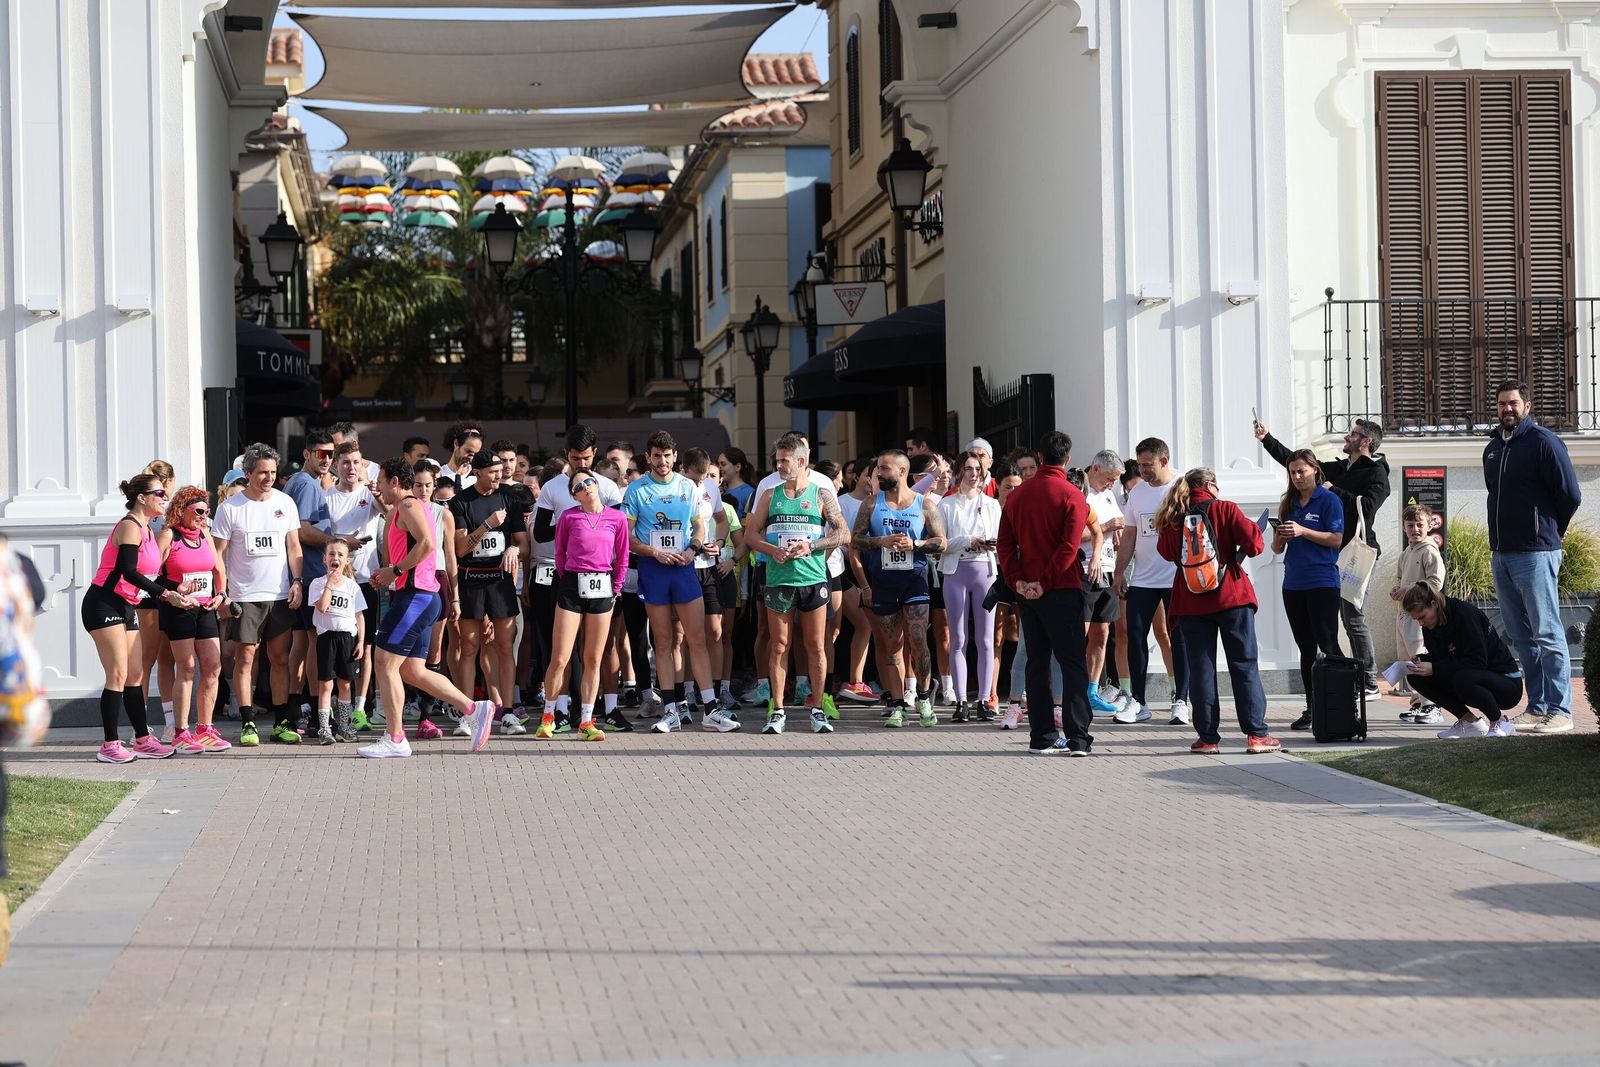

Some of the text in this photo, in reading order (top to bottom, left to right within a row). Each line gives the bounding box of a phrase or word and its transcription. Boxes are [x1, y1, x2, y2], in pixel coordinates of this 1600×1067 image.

[838, 290, 863, 298] GUESS
[776, 515, 809, 523] ATLETISMO
[883, 518, 911, 528] ERESO
[255, 536, 273, 548] 501
[481, 537, 497, 550] 108
[660, 536, 675, 547] 161
[890, 551, 906, 562] 169
[589, 579, 602, 590] 84
[330, 595, 349, 609] 503
